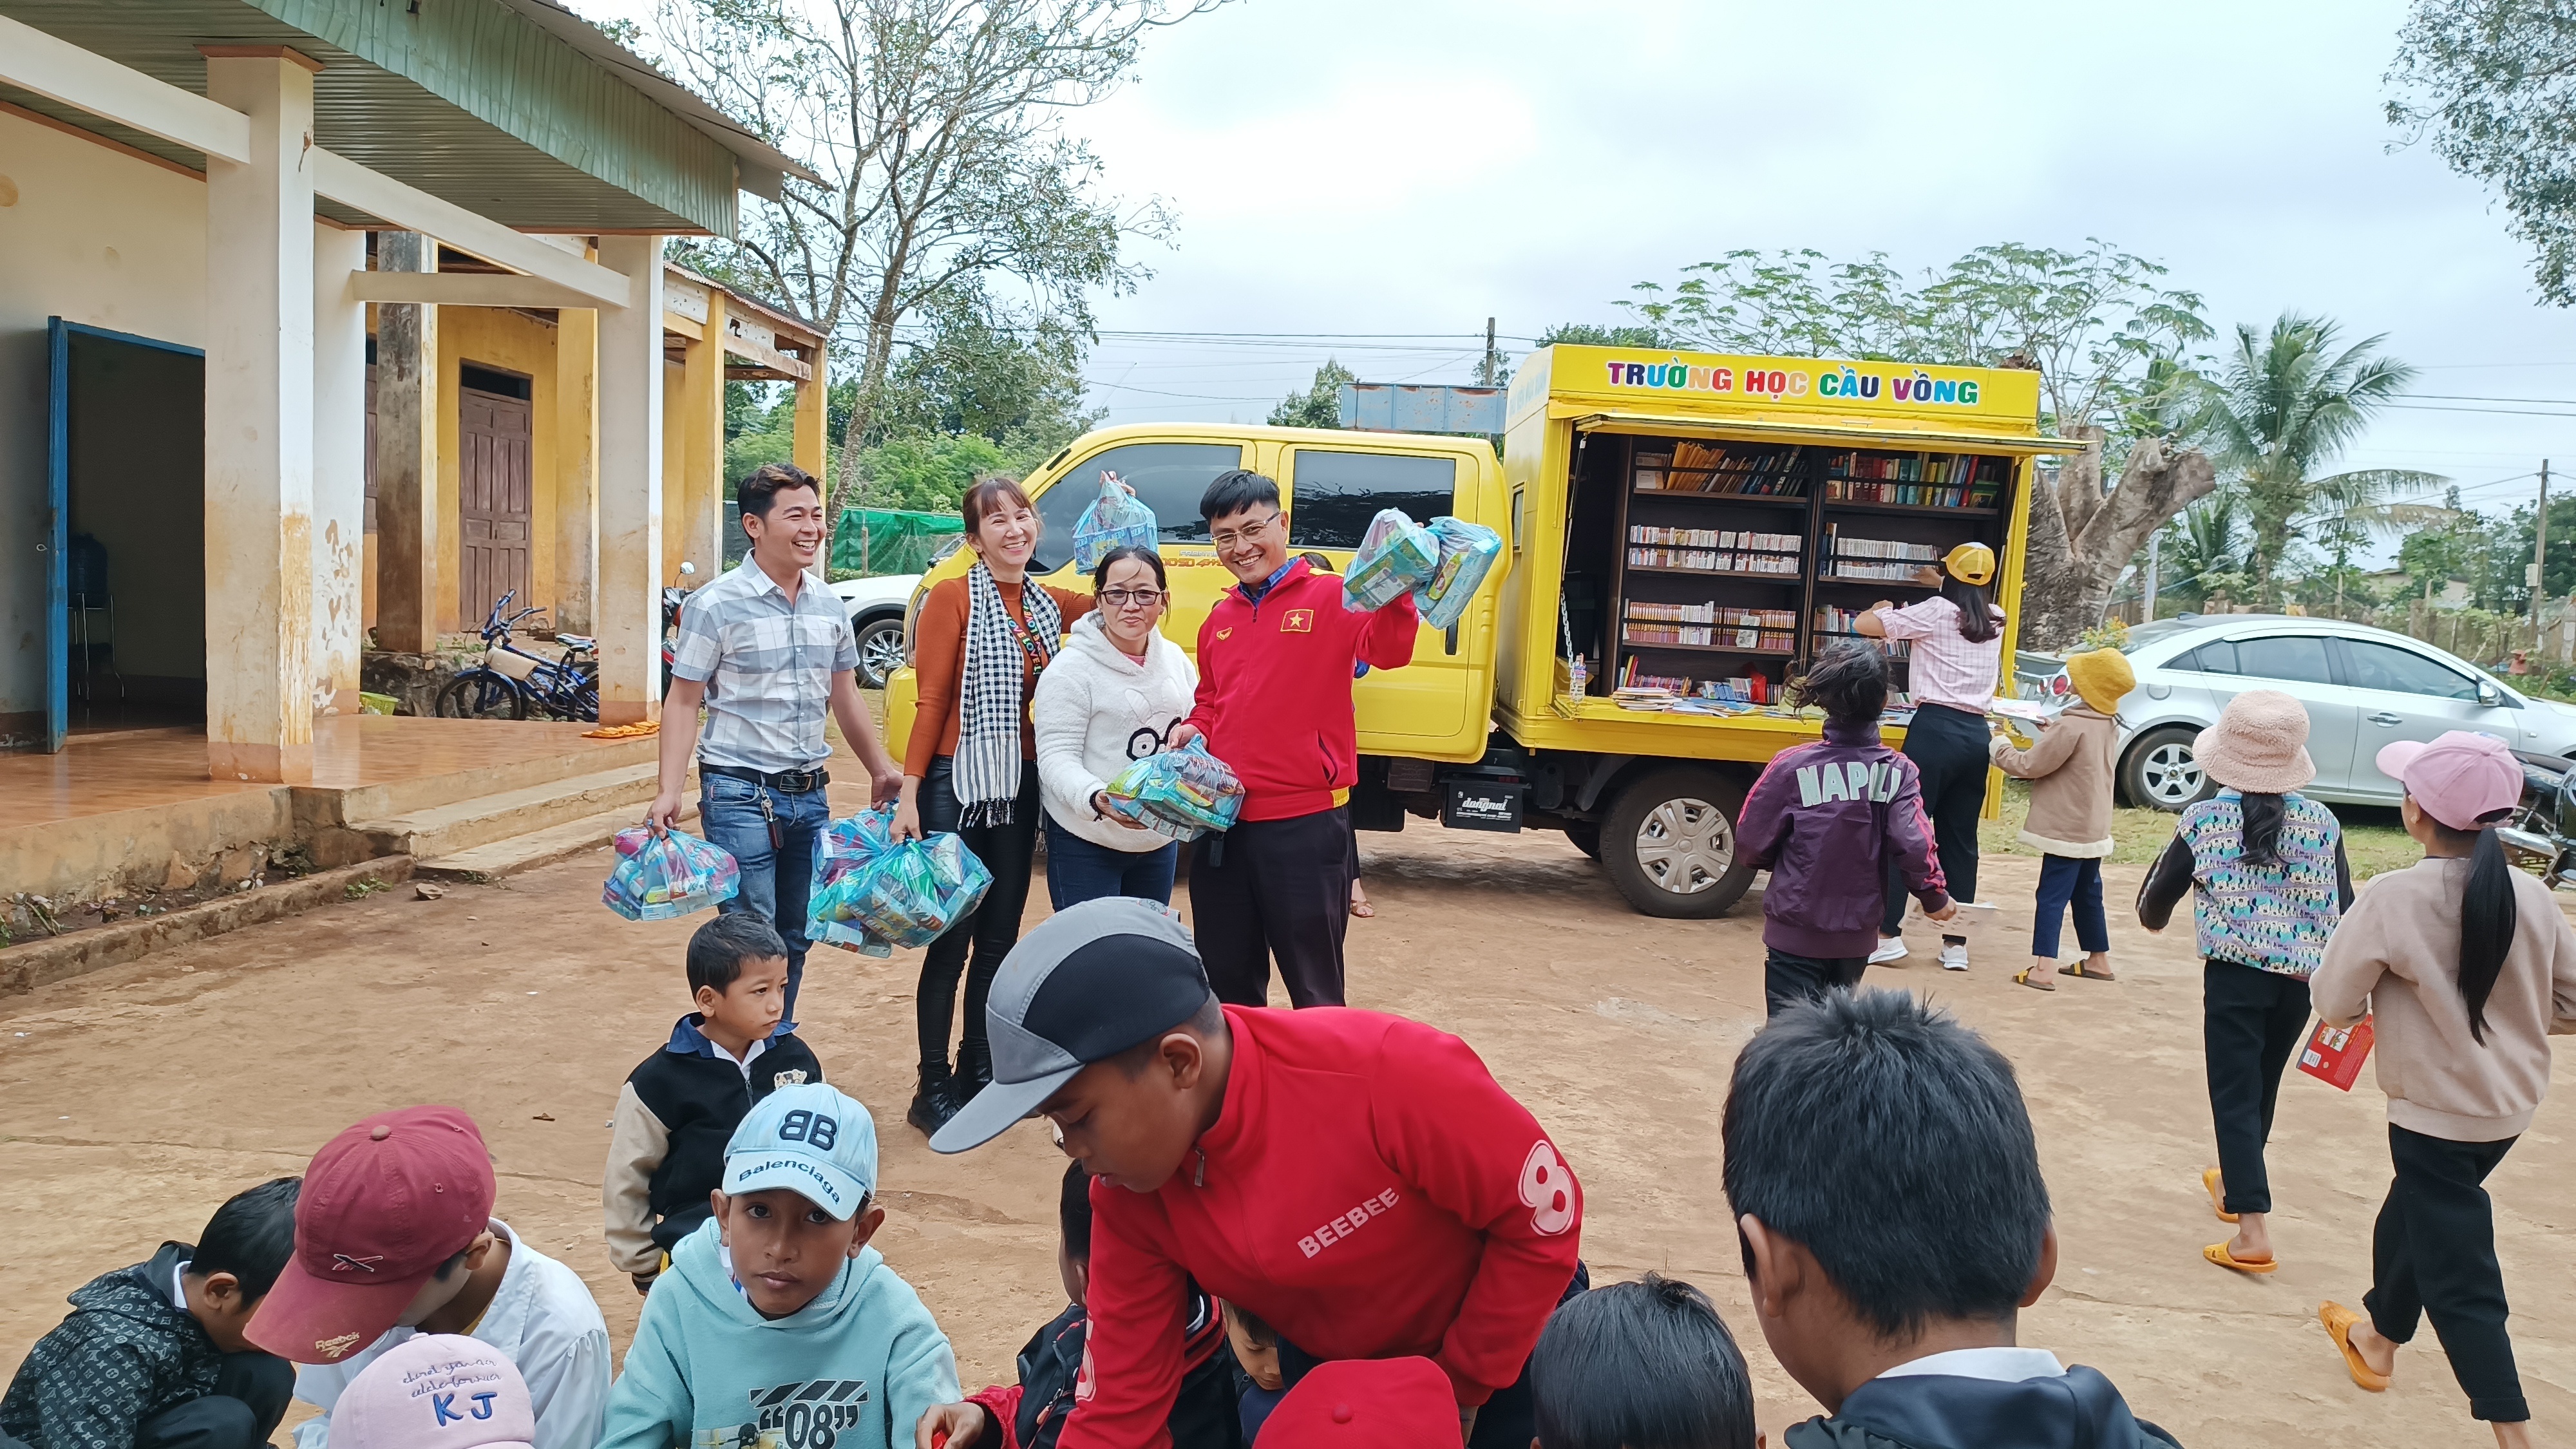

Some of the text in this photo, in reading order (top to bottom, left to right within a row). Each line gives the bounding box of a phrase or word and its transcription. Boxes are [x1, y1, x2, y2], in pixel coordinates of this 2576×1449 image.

[1607, 356, 1978, 404] TRƯỜNG HỌC CẦU VỒNG
[739, 1159, 840, 1205] Balenciaga
[1518, 1139, 1575, 1236] 8
[1297, 1187, 1400, 1259] BEEBEE
